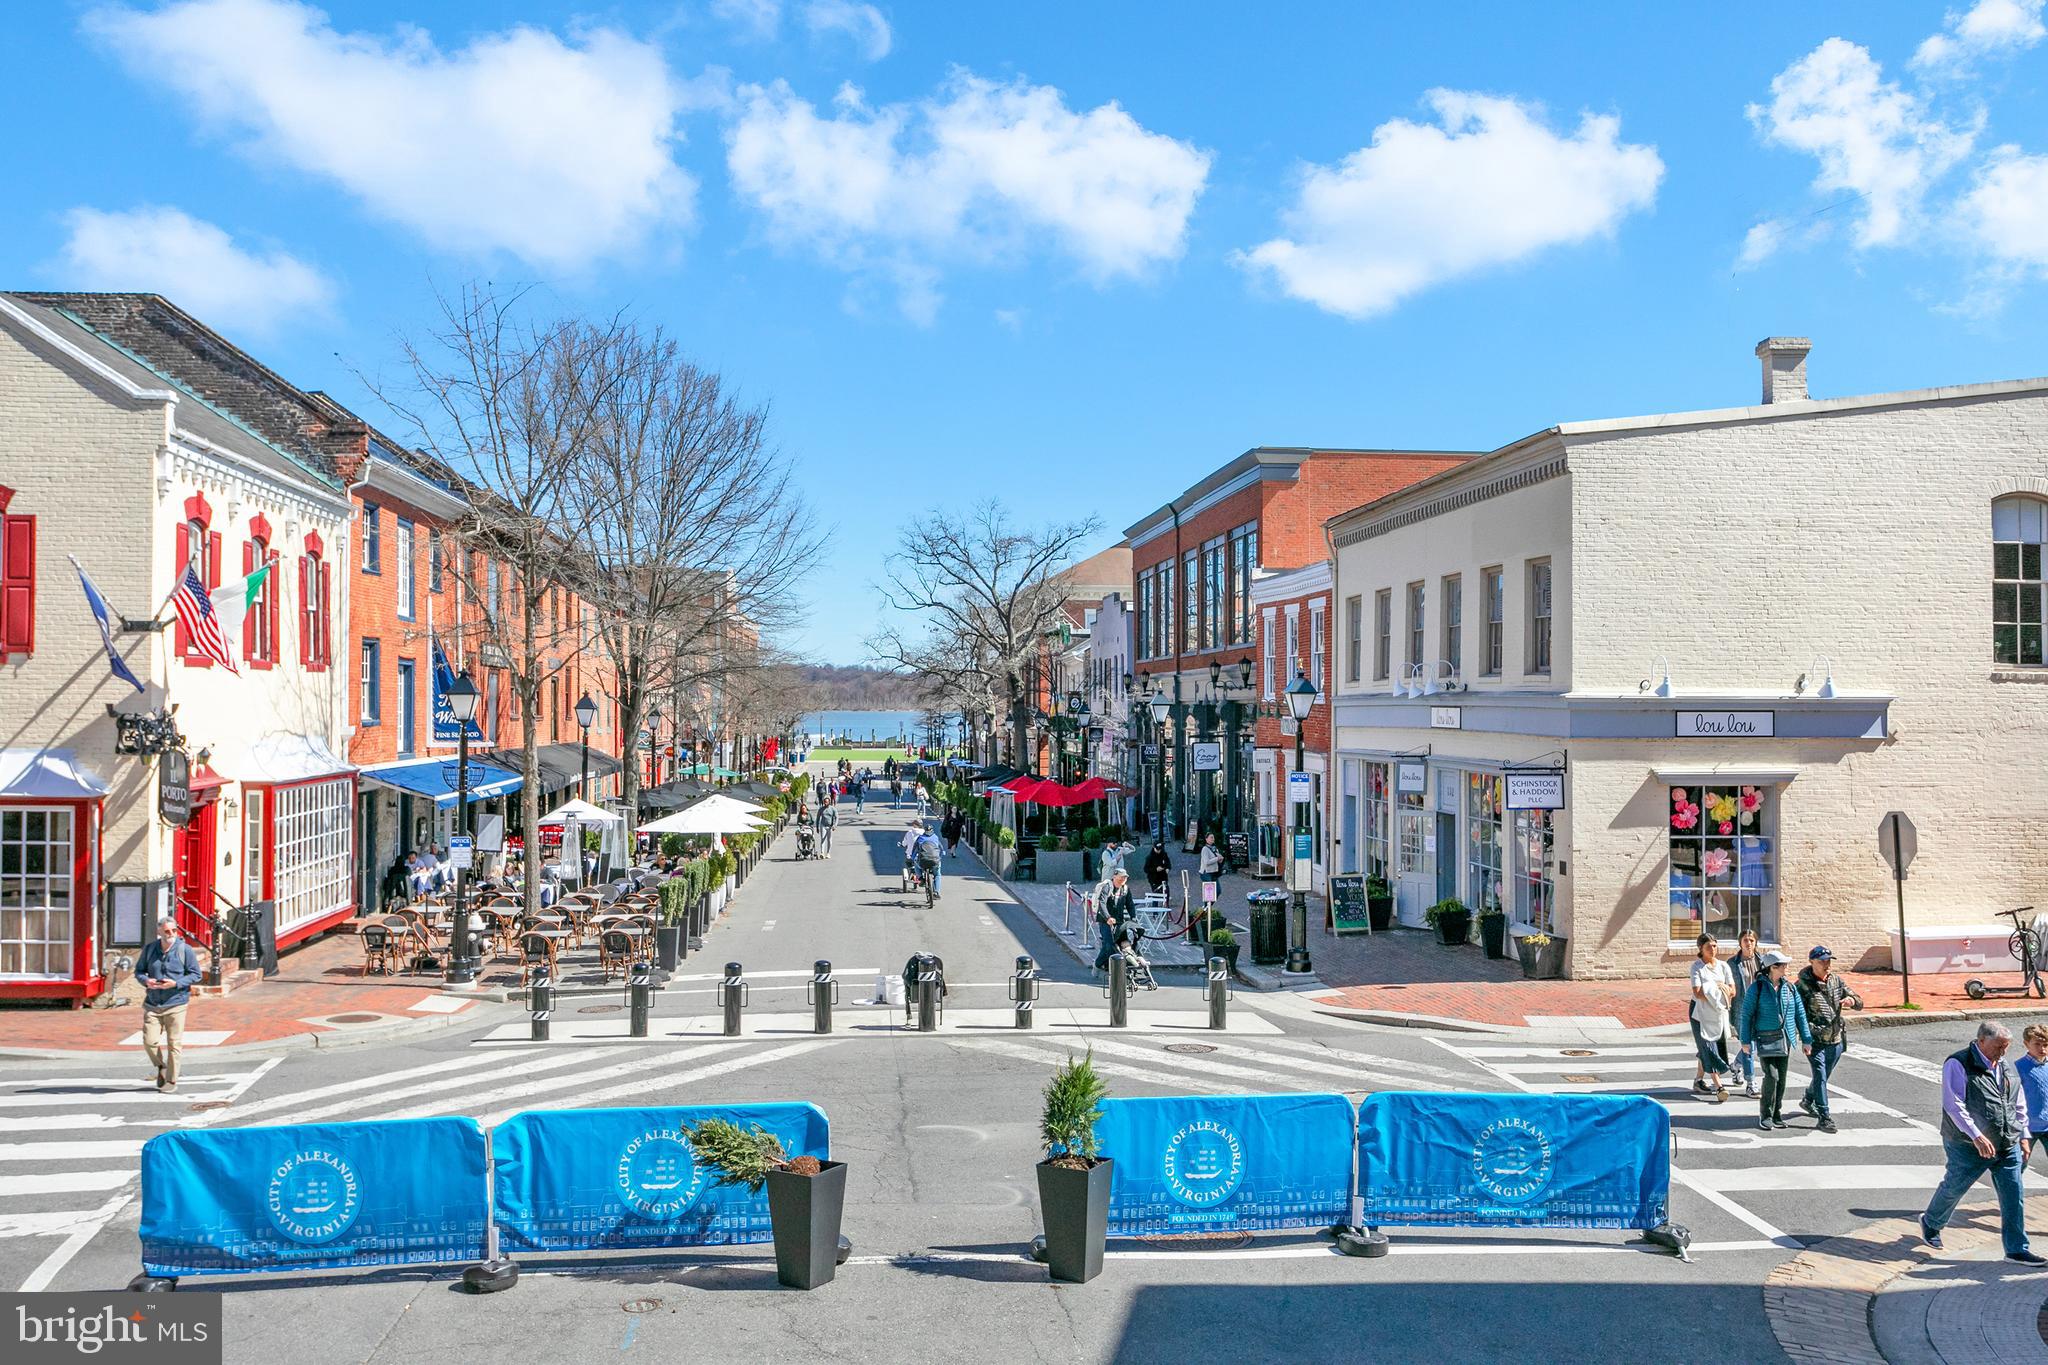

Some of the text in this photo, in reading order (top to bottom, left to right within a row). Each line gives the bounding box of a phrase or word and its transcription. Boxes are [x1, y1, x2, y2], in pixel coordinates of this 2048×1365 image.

[1695, 713, 1756, 733] lou lou
[170, 769, 179, 783] IL
[1511, 780, 1558, 788] SCHINSTOCK
[161, 785, 187, 801] PORTO
[1165, 1120, 1241, 1177] CITY OF ALEXANDRIA
[1473, 1118, 1551, 1171] CITY OF ALEXANDRIA
[618, 1154, 631, 1188] CITY
[627, 1137, 643, 1155] OF
[268, 1150, 357, 1212] CITY OF ALEXANDRIA
[1172, 1178, 1234, 1202] VIRGINIA
[1480, 1174, 1544, 1198] VIRGINIA
[627, 1190, 696, 1214] VIRGINIA
[279, 1212, 350, 1238] VIRGINIA
